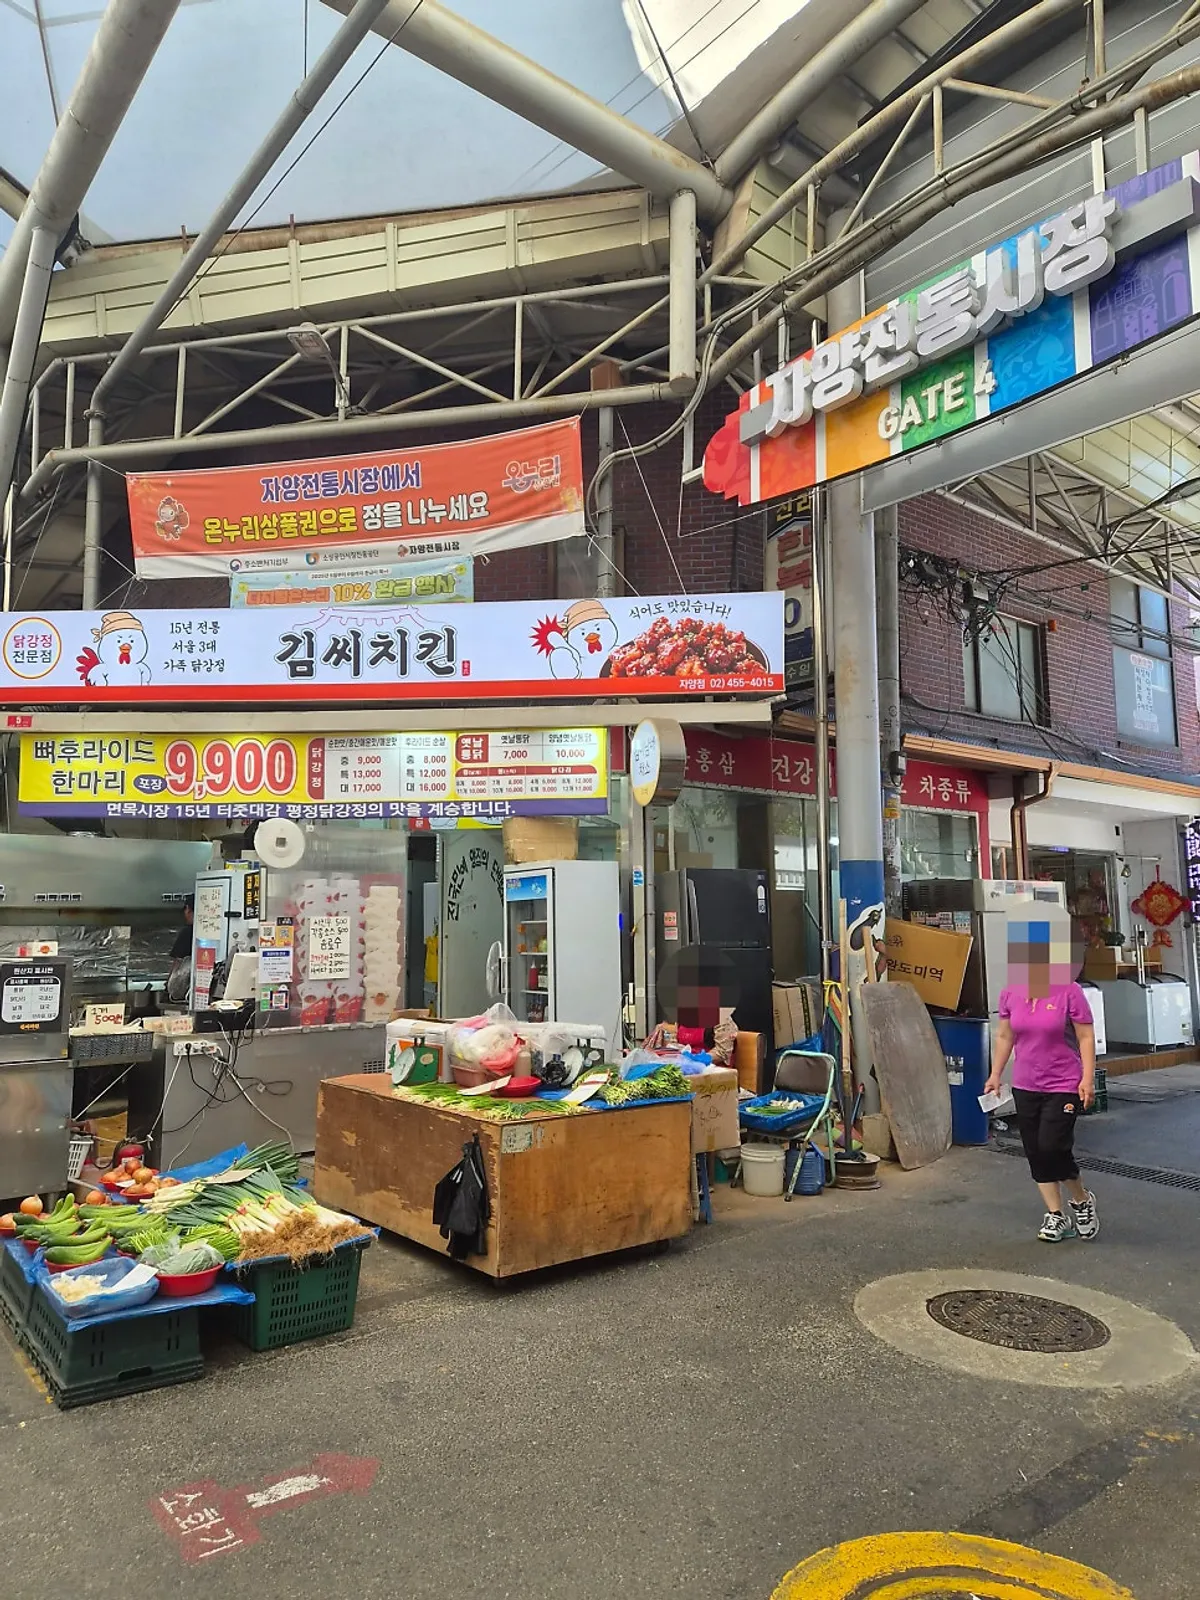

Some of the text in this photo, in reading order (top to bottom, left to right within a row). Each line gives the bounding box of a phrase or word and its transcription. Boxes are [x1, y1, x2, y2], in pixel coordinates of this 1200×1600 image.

[765, 193, 1121, 437] 자양전통시장
[878, 359, 997, 441] GATE 4
[261, 461, 422, 504] 자양전통시장에서
[203, 491, 489, 544] 온누리상품권으로 정을 나누세요
[409, 541, 460, 555] 자양전통시장
[332, 582, 372, 602] 10%
[375, 577, 413, 598] 환급
[415, 572, 456, 595] 행사
[629, 598, 733, 620] 식어도 맛있습니다!
[169, 620, 221, 635] 15년 전통
[13, 634, 52, 649] 닭강정
[172, 640, 217, 653] 서울 3대
[12, 649, 52, 664] 전문점
[275, 625, 457, 680] 김씨치킨
[164, 658, 226, 674] 가족 닭강정
[679, 677, 774, 690] 자양점 02) 455-4015
[405, 737, 431, 747] 후라이드
[433, 736, 446, 747] 순살
[501, 734, 530, 744] 옛날통닭
[34, 739, 156, 765] 뼈후라이드
[357, 755, 382, 765] 9,000
[423, 755, 446, 764] 8,000
[503, 749, 585, 759] 7,000 10,000
[51, 738, 297, 800] 한마리 포장 9,900
[311, 747, 323, 788] 닭강정
[684, 747, 736, 776] 홍삼
[353, 769, 382, 778] 13,000
[420, 769, 446, 778] 12,000
[340, 783, 446, 793] 대 17,000 대 16,000
[919, 775, 972, 804] 차종류
[106, 801, 516, 818] 면목시장 15년 터줏대감 평정닭강정의 맛을 계승합니다.
[886, 959, 944, 982] 완도미역
[94, 1014, 122, 1025] 500원
[158, 1491, 243, 1558] 소화기
